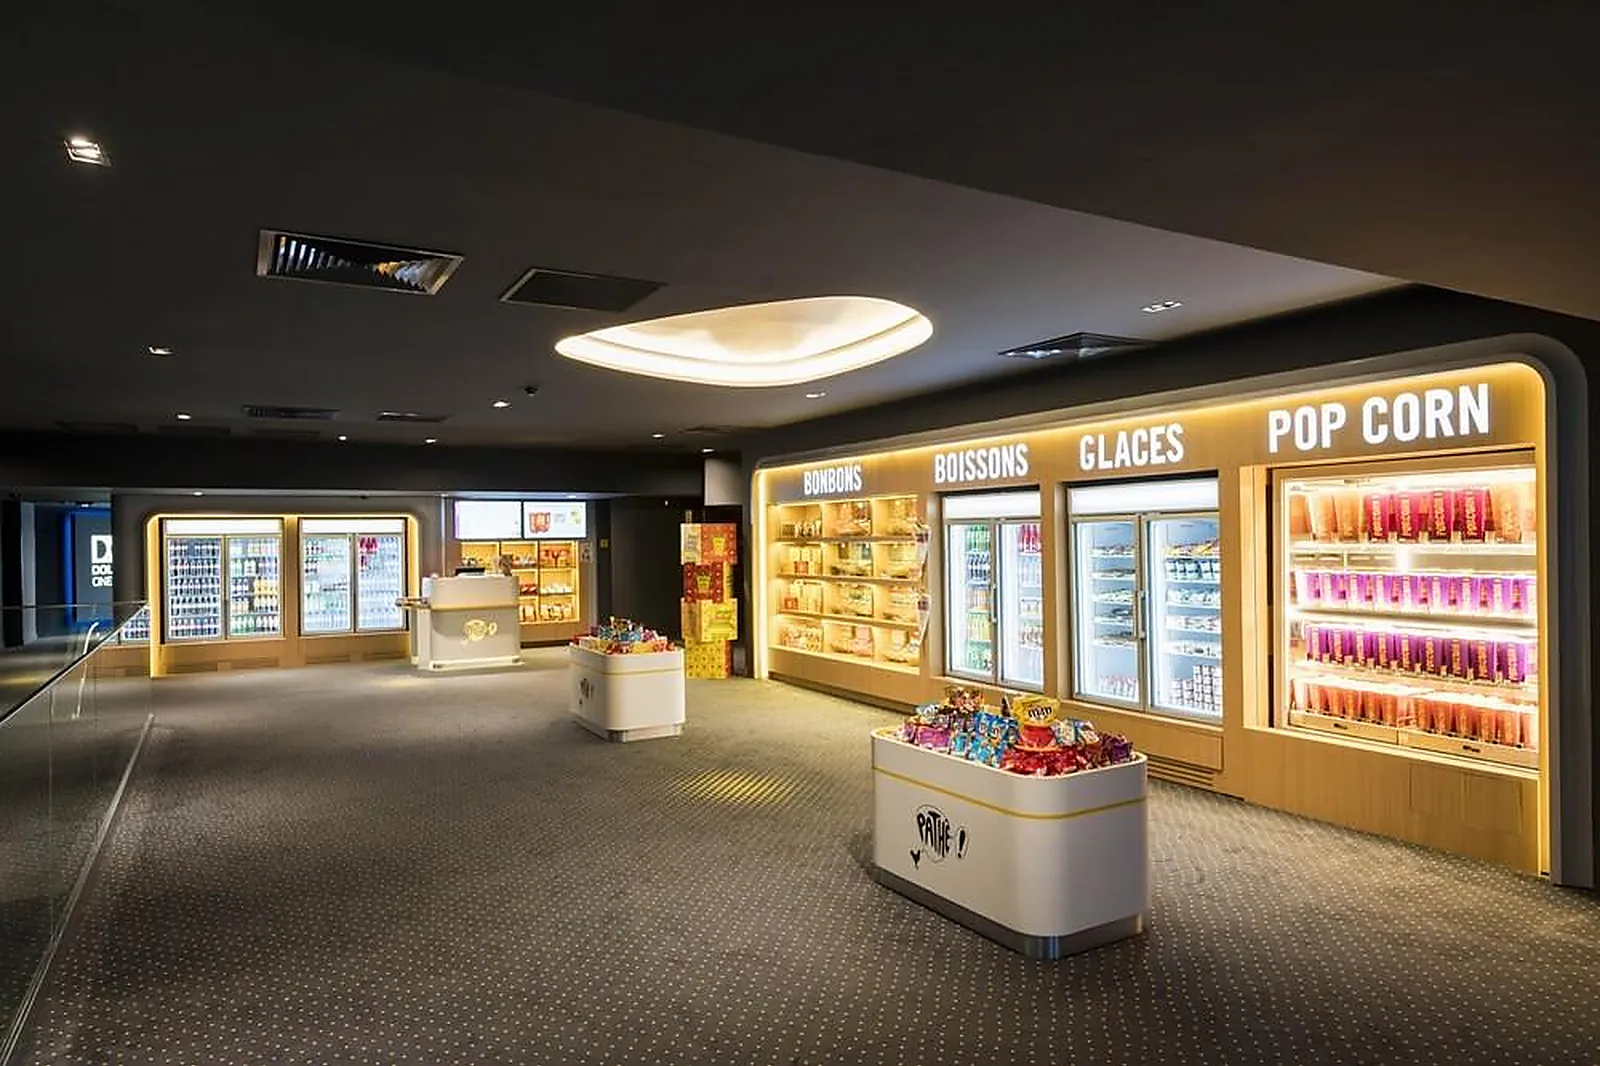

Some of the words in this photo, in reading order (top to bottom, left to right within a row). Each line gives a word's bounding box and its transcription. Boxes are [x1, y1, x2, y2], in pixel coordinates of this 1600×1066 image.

[1267, 402, 1346, 454] POP
[1363, 383, 1490, 443] CORN
[934, 443, 1028, 484] BOISSONS
[1079, 424, 1184, 470] GLACES
[803, 464, 863, 495] BONBONS
